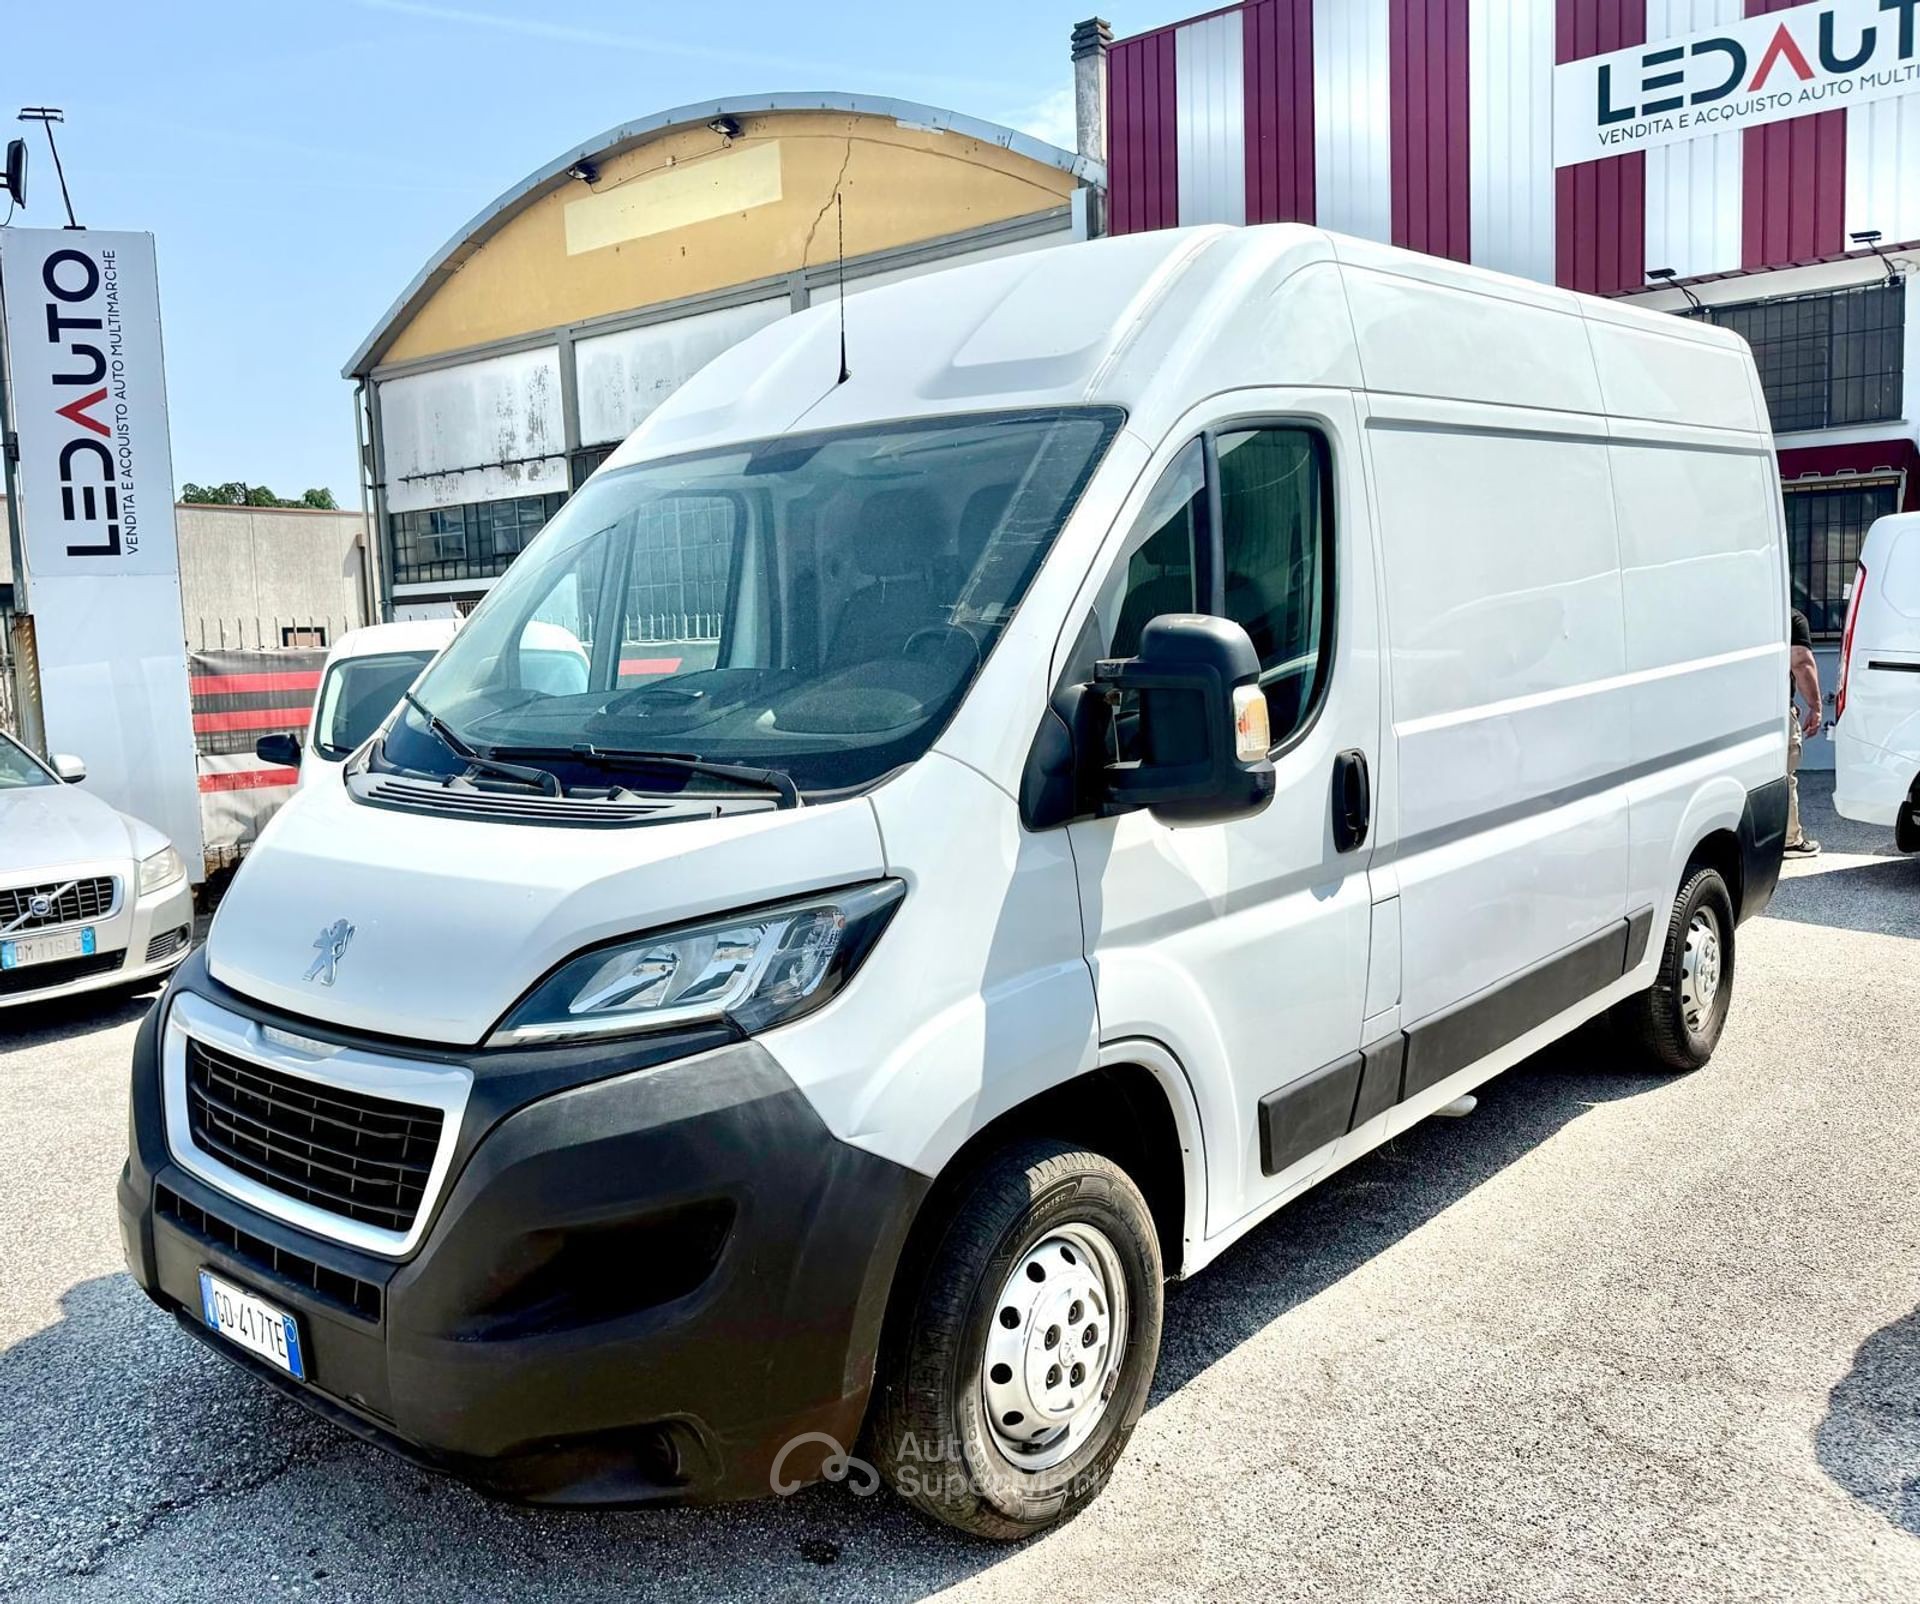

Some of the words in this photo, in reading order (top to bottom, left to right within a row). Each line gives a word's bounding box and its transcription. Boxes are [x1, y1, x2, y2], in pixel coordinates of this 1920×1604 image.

[1598, 119, 1674, 146] VENDITA
[1679, 114, 1689, 128] E
[1694, 92, 1793, 125] ACQUISTO
[1798, 79, 1854, 104] AUTO
[103, 250, 124, 356] MULTIMARCHE
[42, 249, 121, 556] LEDAUTO
[111, 360, 127, 400] AUTO
[116, 405, 134, 478] ACQUISTO
[122, 482, 134, 492] E
[125, 493, 139, 555] VENDITA
[240, 1303, 287, 1358] 417TE
